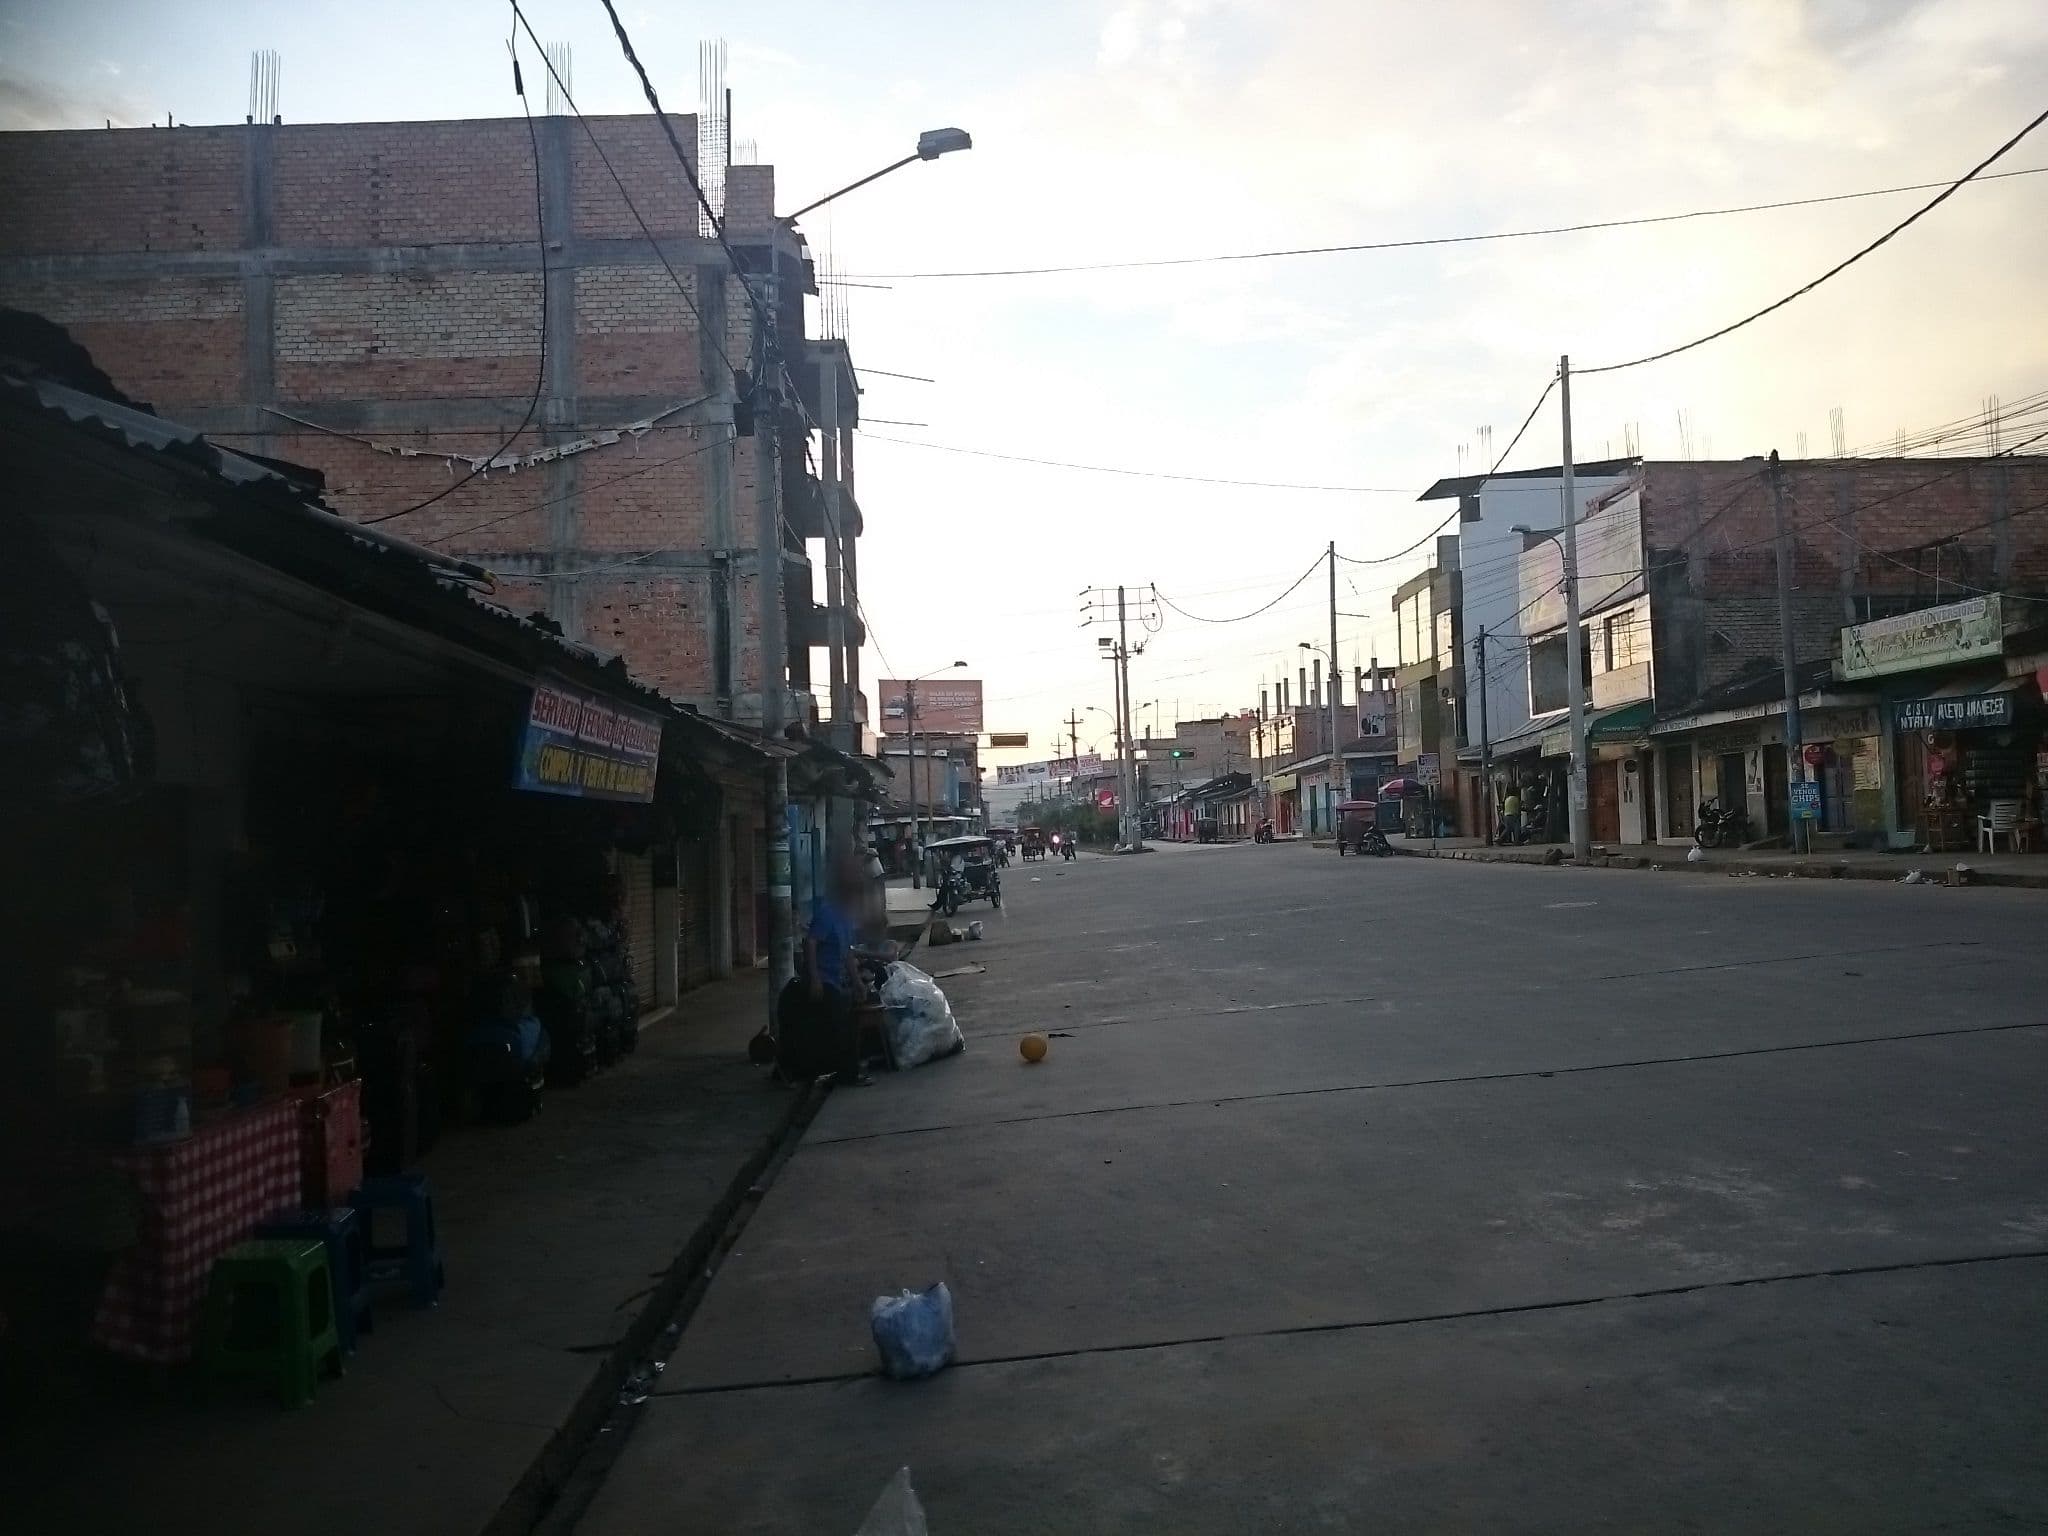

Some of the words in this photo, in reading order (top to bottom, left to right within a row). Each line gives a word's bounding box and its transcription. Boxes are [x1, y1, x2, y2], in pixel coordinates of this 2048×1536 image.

[532, 689, 580, 732] SERVICIO
[1938, 702, 1964, 719] NUEVO
[1791, 794, 1820, 802] CHIPS
